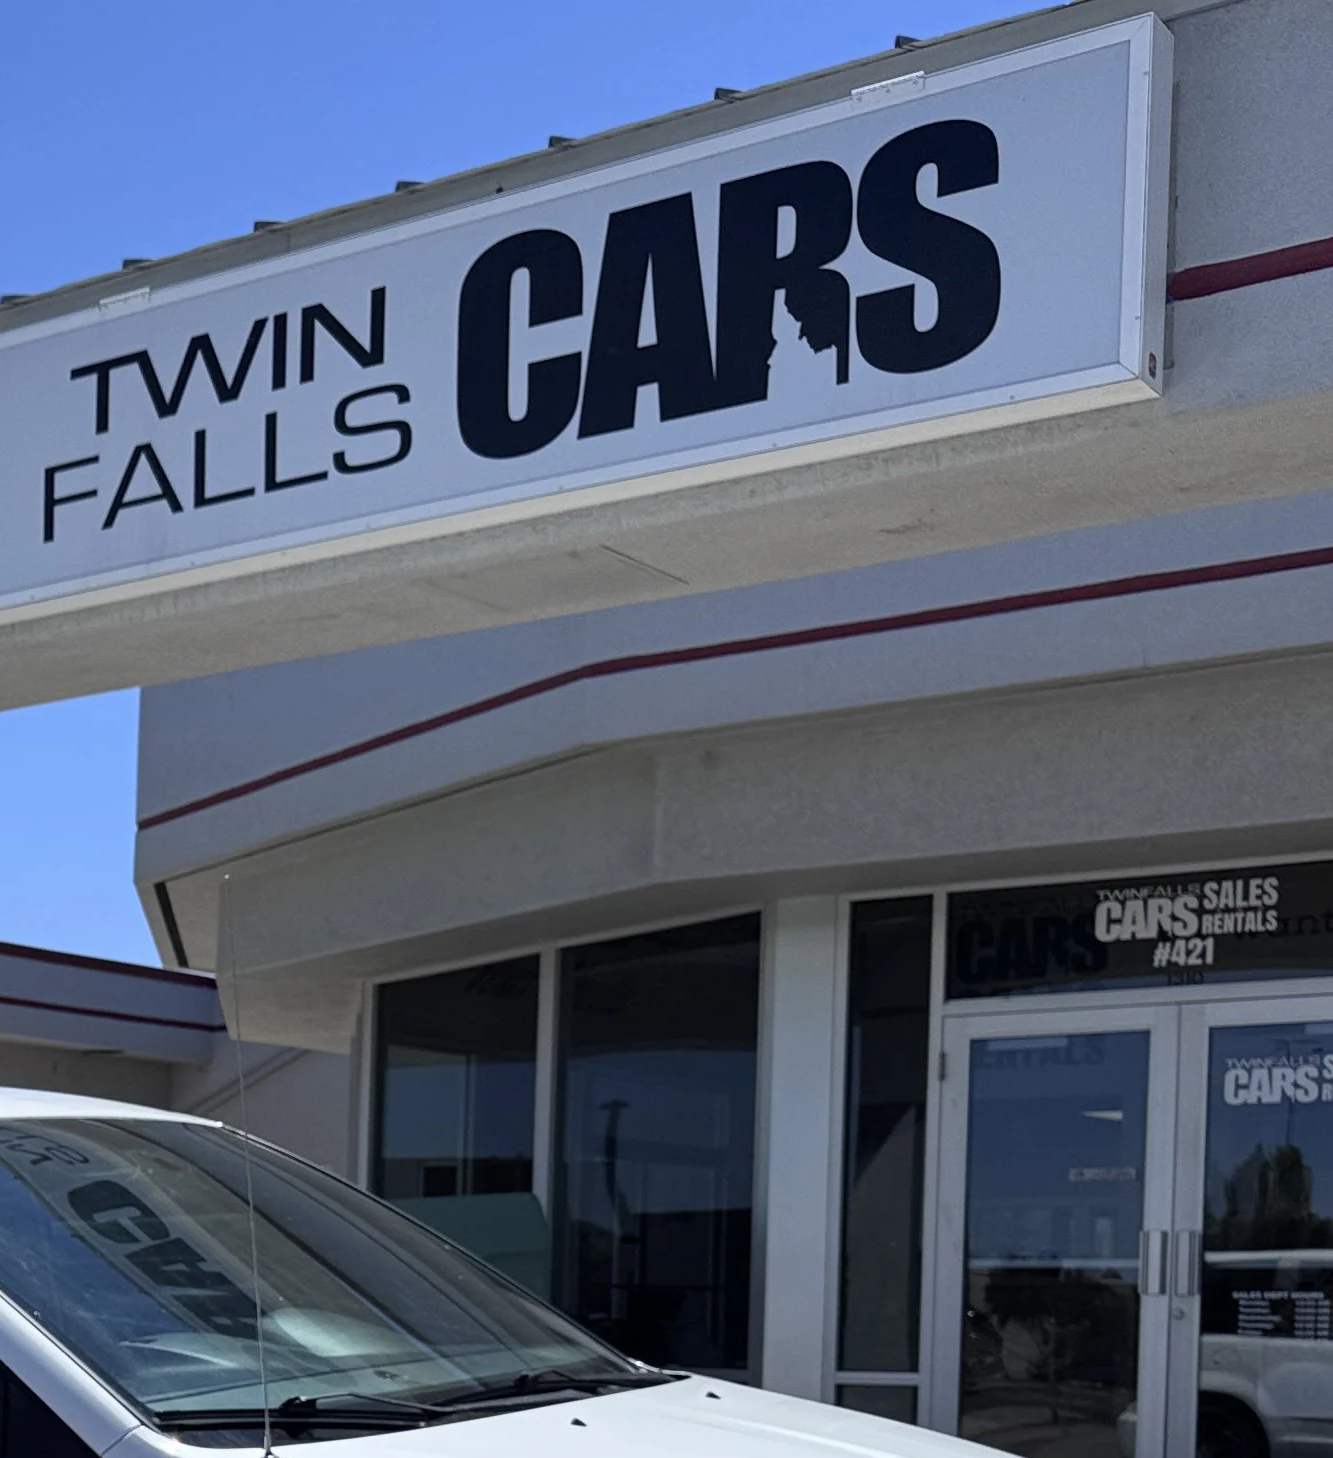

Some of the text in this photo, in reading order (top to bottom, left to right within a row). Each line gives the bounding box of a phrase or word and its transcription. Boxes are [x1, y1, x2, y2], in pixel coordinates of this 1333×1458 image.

[457, 118, 1001, 460] CARS
[70, 286, 385, 435] TWIN
[43, 383, 412, 544] FALLS
[1202, 876, 1279, 910] SALES
[1094, 894, 1199, 943] CARS
[1201, 909, 1278, 935] RENTALS
[1153, 937, 1215, 968] #421
[1223, 1064, 1319, 1106] CARS
